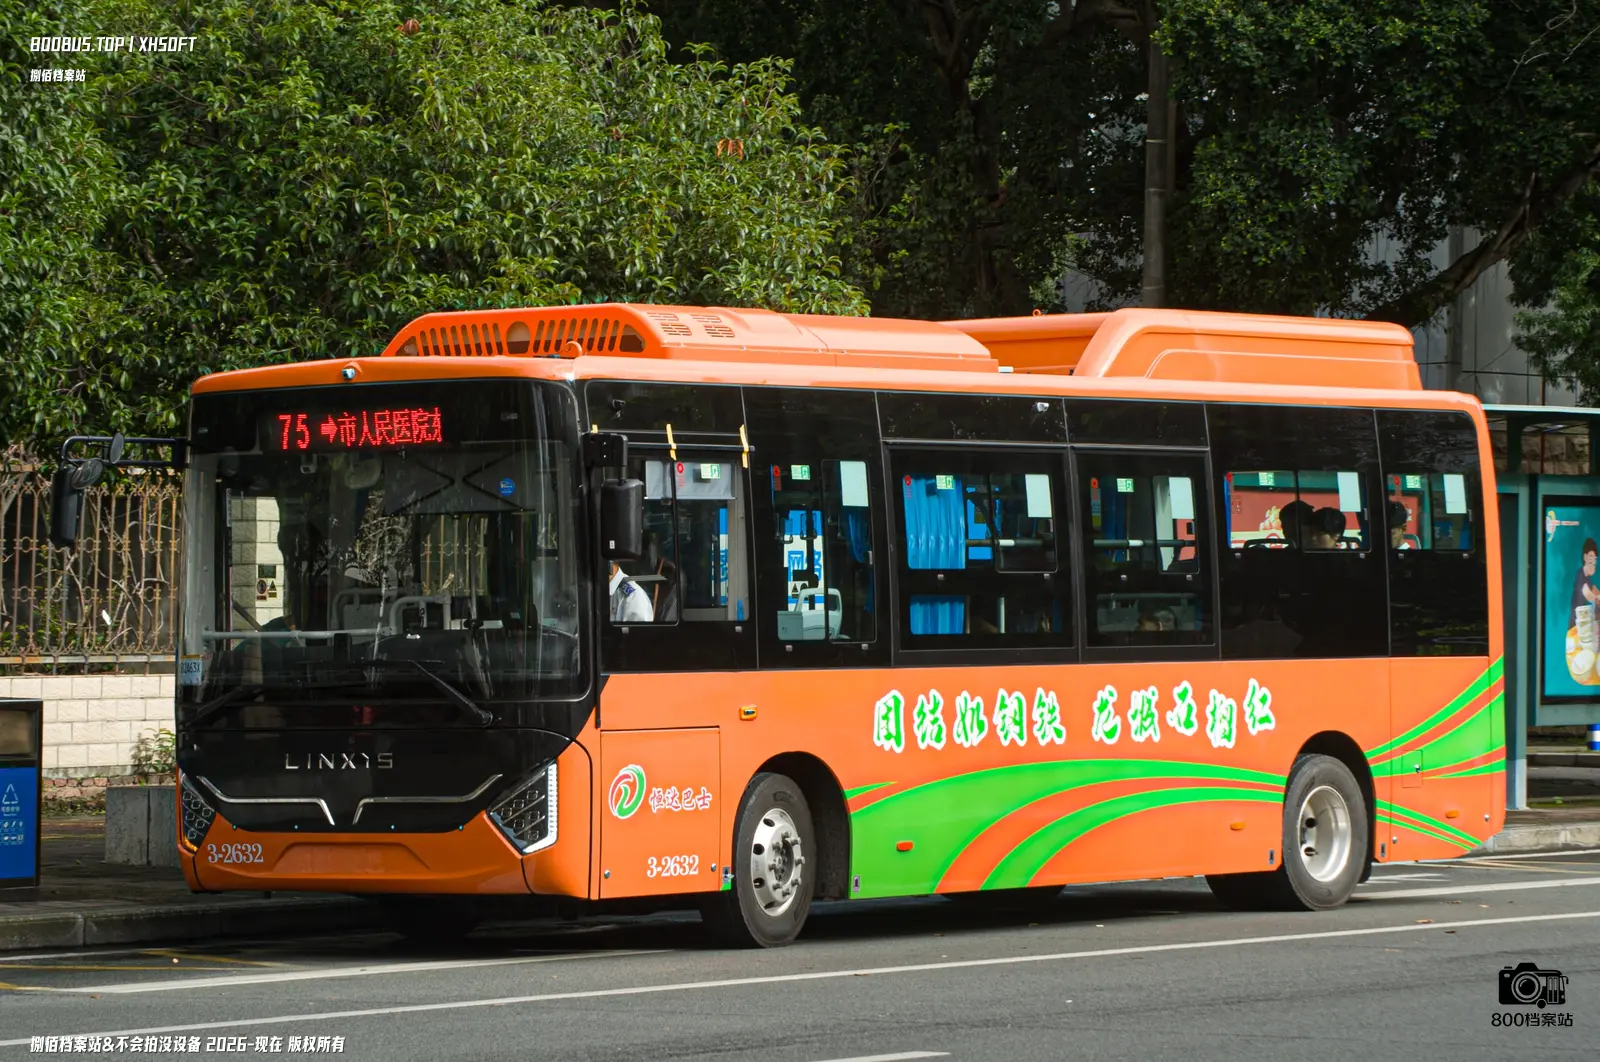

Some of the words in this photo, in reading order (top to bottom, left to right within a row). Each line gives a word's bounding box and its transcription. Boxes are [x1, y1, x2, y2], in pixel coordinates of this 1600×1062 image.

[278, 414, 310, 450] 75
[873, 687, 1067, 753] 团结如钢铁
[1092, 679, 1276, 749] 龙城石榴红
[649, 786, 712, 813] 恒达巴士
[207, 843, 264, 864] 3-2632
[647, 854, 699, 877] 3-2632
